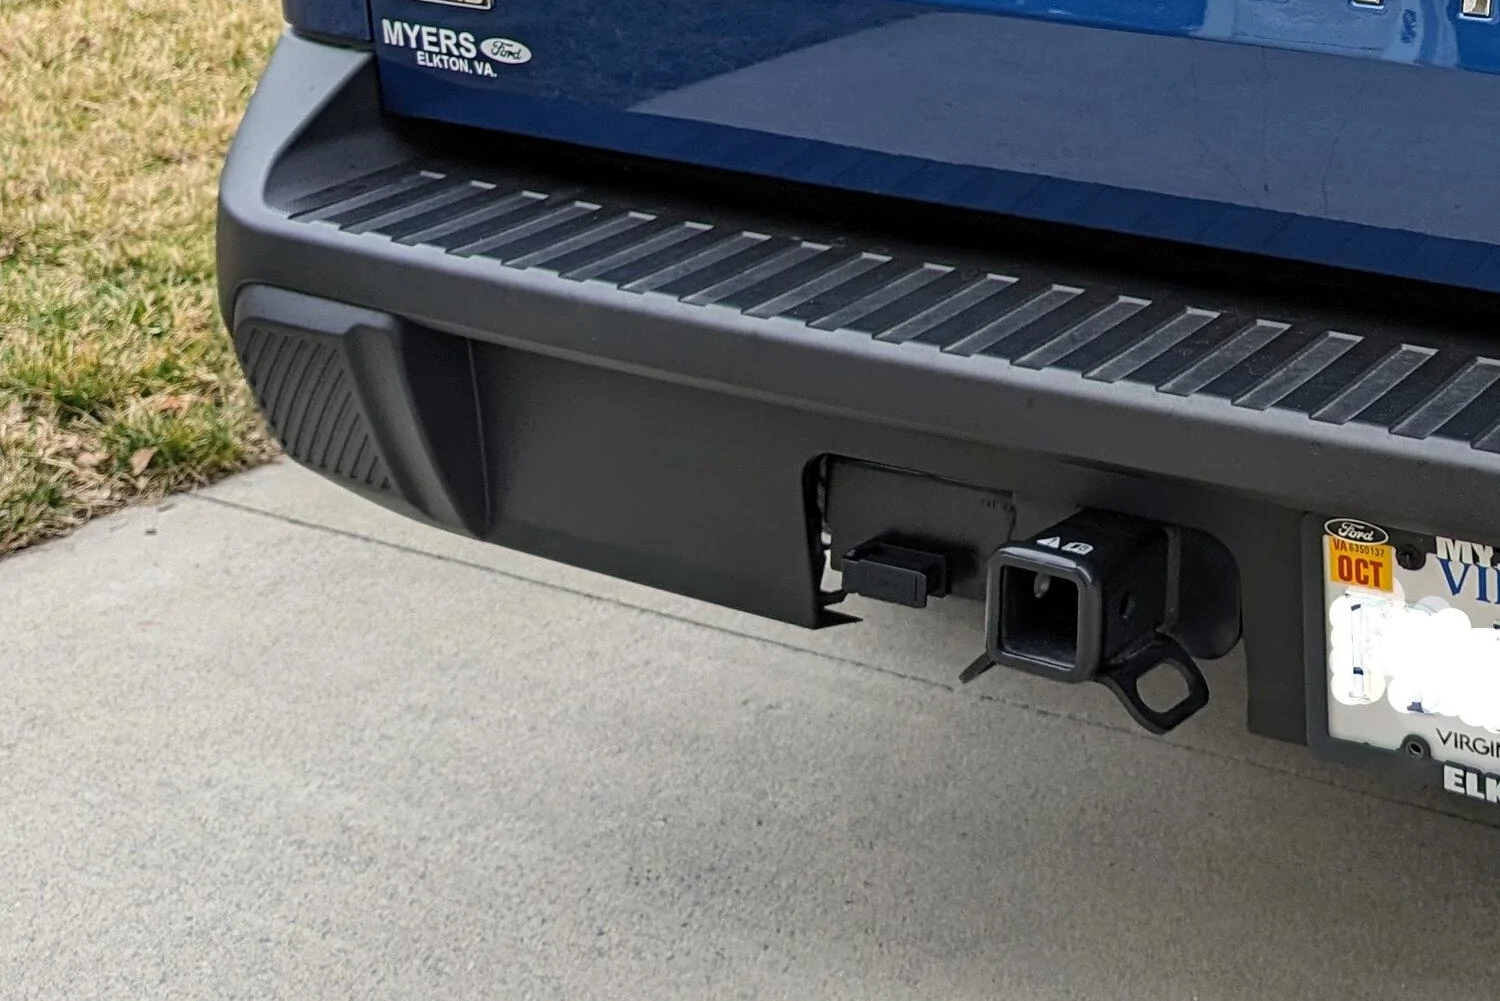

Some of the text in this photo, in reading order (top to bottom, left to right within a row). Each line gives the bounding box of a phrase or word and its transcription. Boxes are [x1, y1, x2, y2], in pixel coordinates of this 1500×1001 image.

[382, 19, 477, 59] MYERS
[1332, 536, 1348, 552] VA
[1338, 555, 1384, 588] OCT
